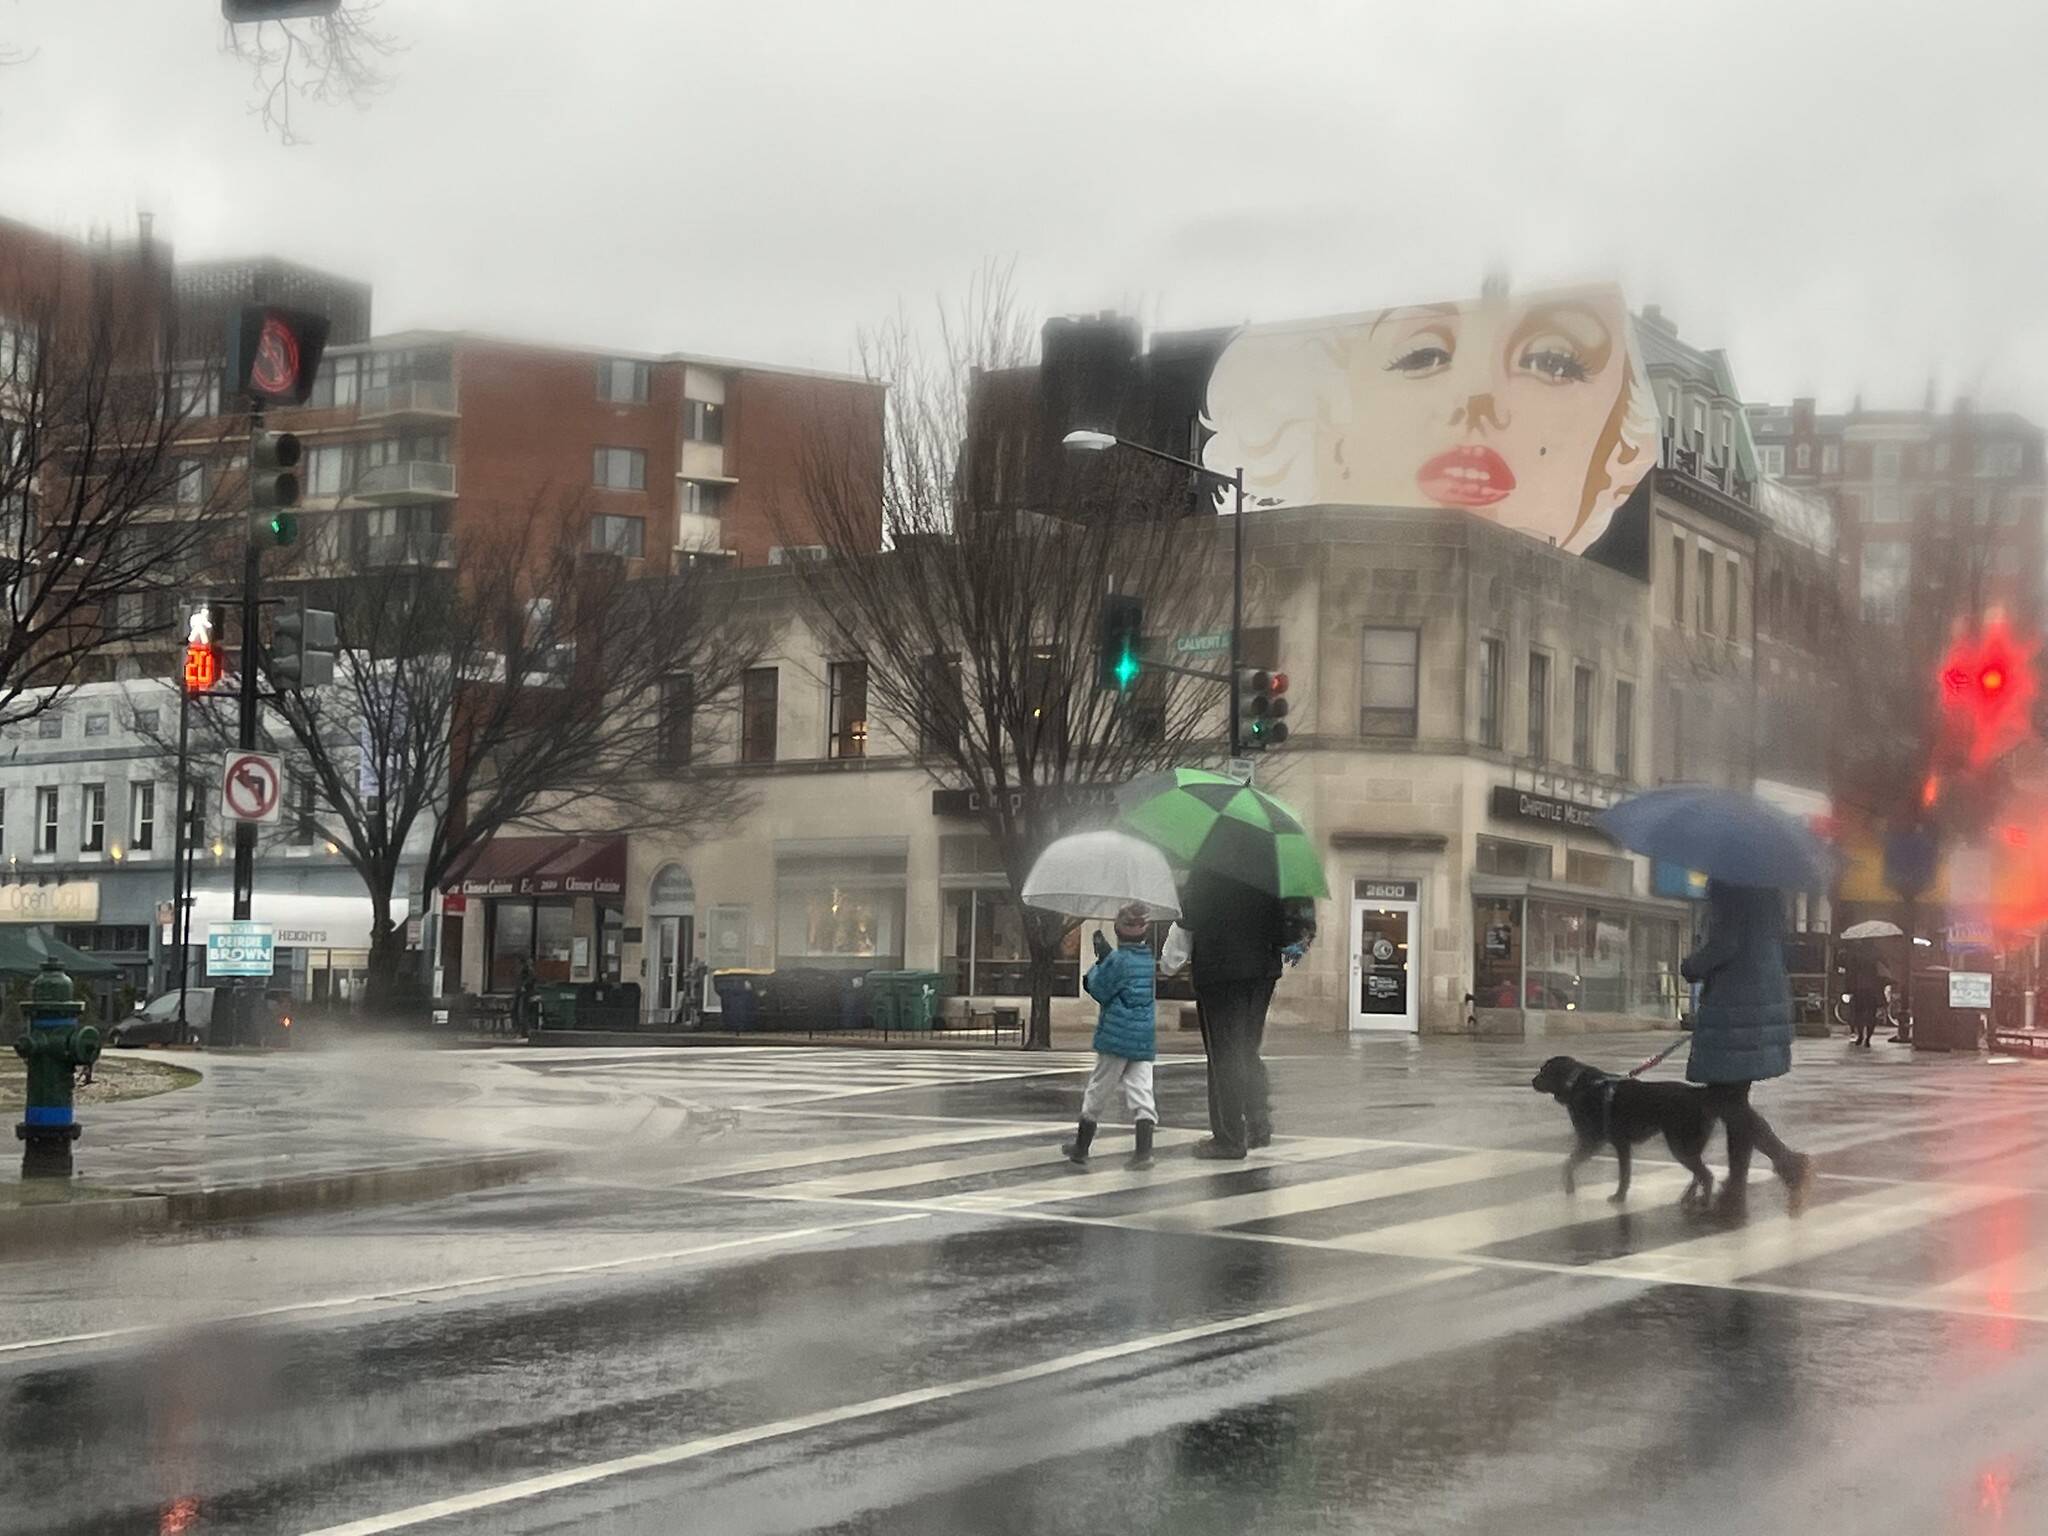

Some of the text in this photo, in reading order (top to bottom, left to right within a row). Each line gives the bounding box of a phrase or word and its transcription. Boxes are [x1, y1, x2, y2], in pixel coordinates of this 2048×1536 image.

[1177, 635, 1220, 650] CALVERT
[185, 649, 212, 683] 20
[1366, 884, 1405, 897] 2600
[278, 929, 327, 942] HEIGHTS
[208, 948, 270, 961] BROWN
